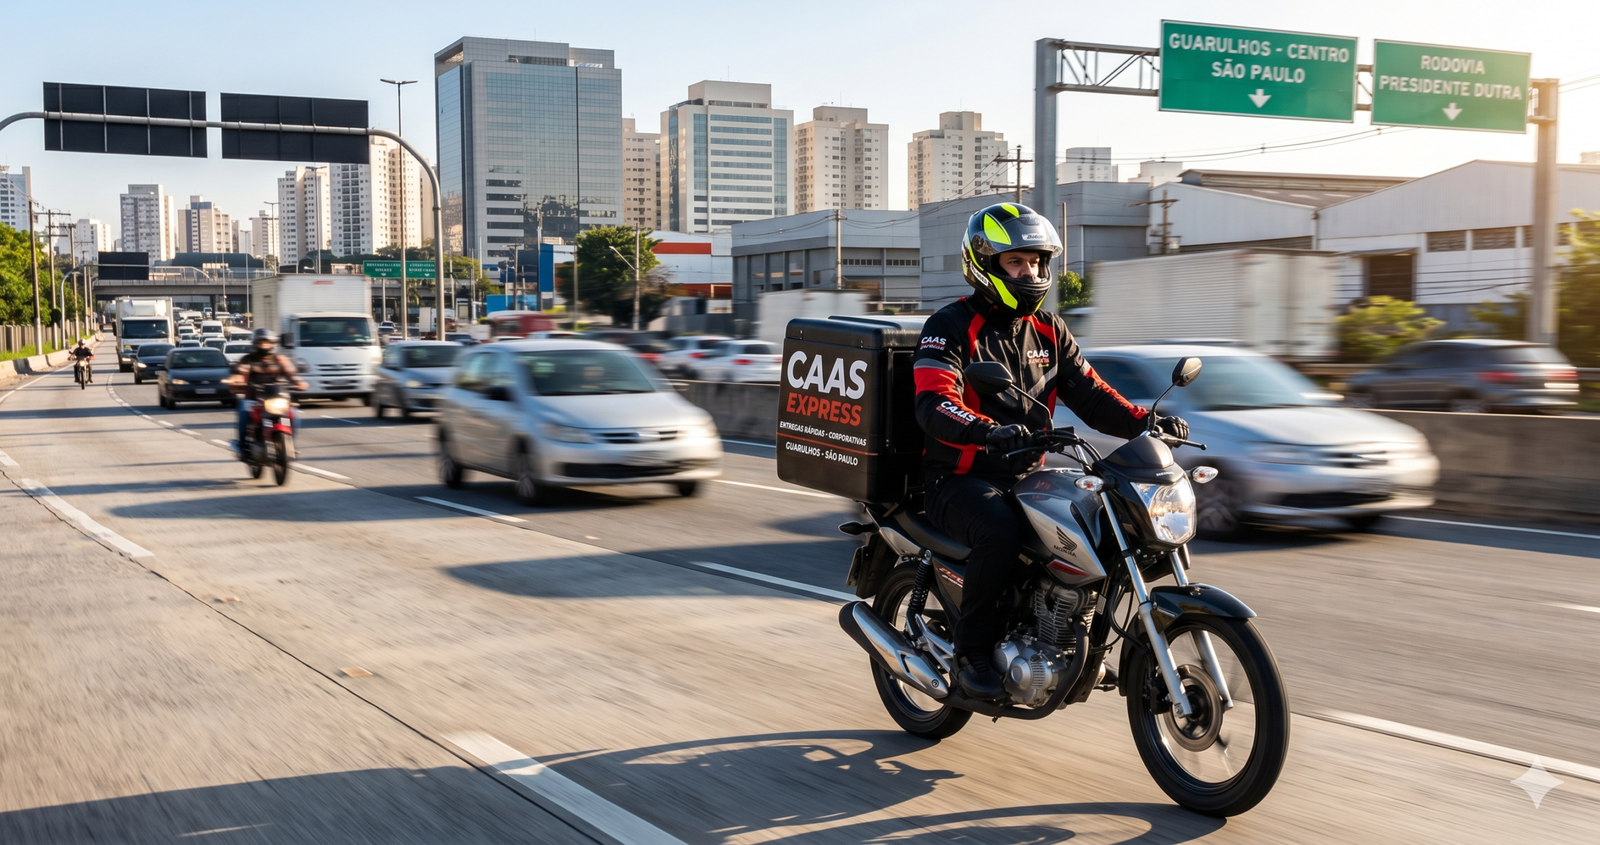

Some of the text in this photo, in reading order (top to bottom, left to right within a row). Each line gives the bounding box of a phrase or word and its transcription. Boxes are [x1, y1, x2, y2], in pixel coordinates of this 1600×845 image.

[1169, 33, 1271, 56] GUARULHOS
[1287, 43, 1350, 63] CENTRO
[1211, 59, 1306, 83] SÃO PAULO
[1421, 55, 1486, 74] RODOVIA
[1379, 75, 1523, 100] PRESIDENTE DUTRA
[921, 336, 947, 346] CAAS
[1026, 349, 1049, 358] CAAS
[787, 350, 868, 400] CAAS
[786, 392, 862, 427] EXPRESS
[940, 401, 977, 422] CAAS
[780, 420, 804, 433] ENTREGAS
[804, 425, 825, 437] RÁPIDAS
[828, 431, 867, 447] CORPORATIVAS
[785, 441, 821, 457] GUARULHOS
[838, 454, 859, 466] PAULO
